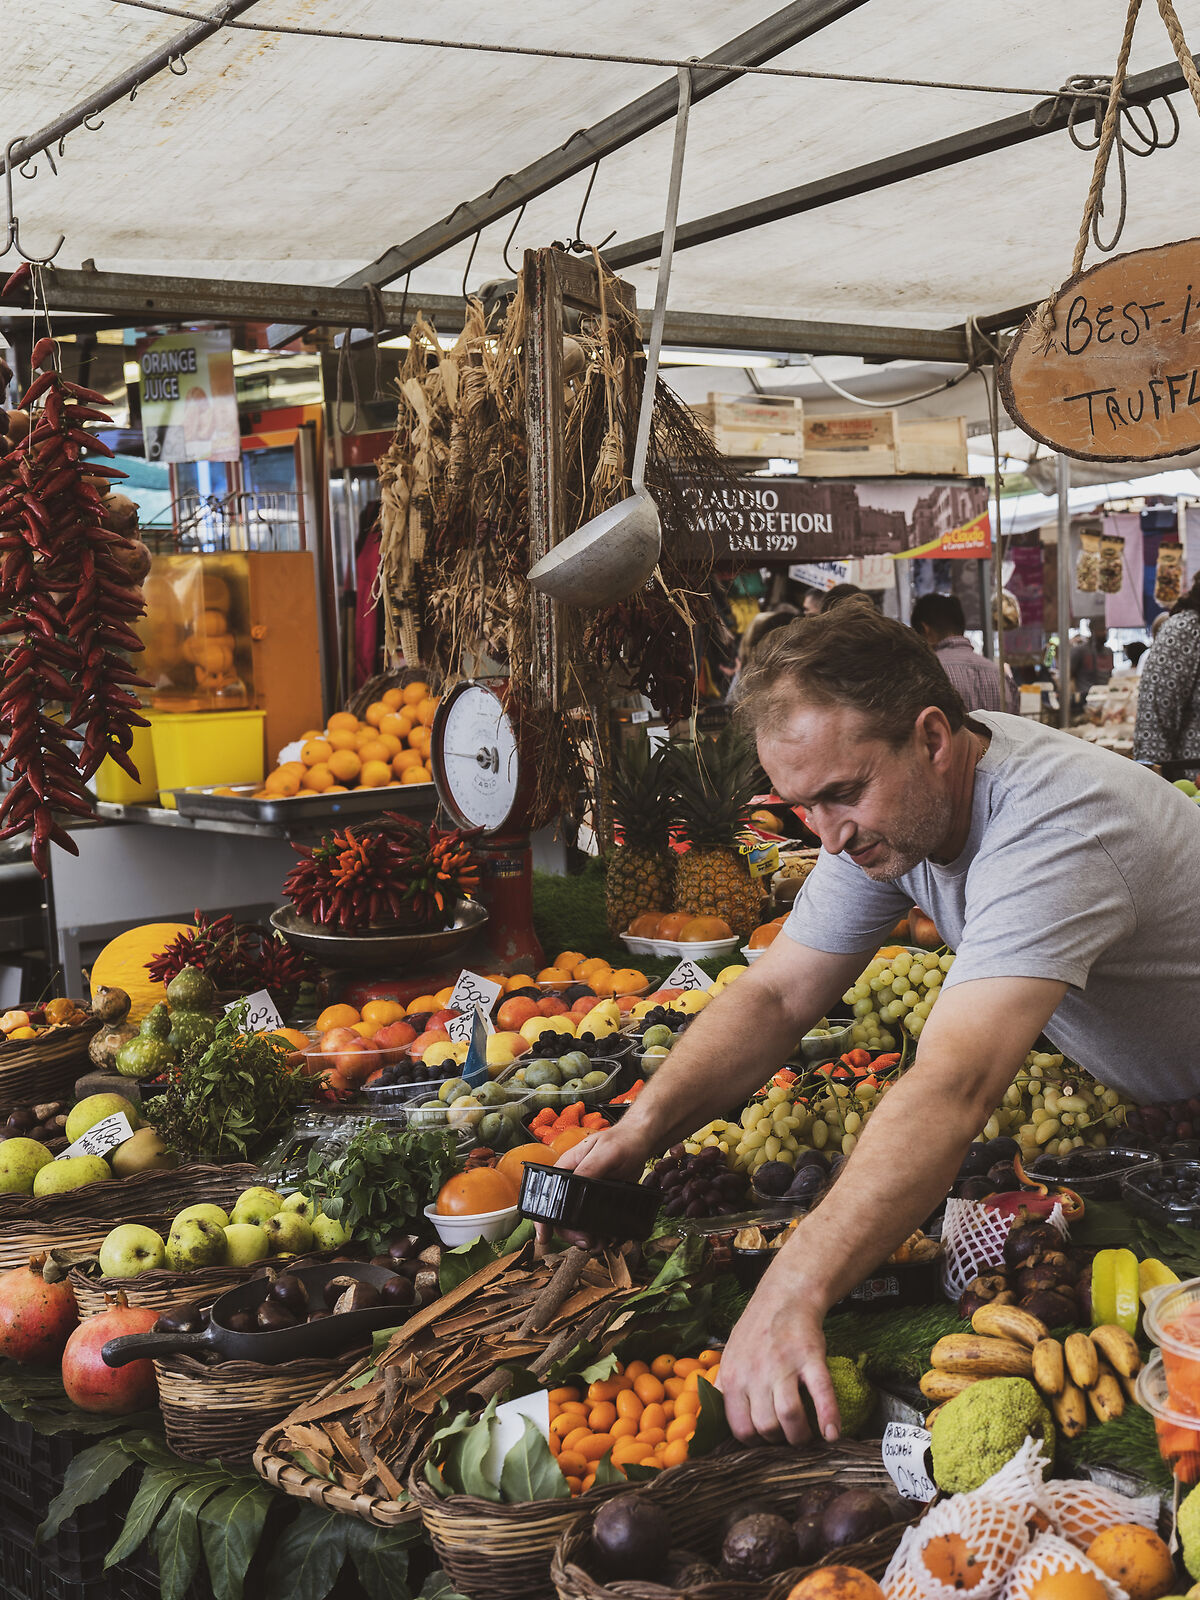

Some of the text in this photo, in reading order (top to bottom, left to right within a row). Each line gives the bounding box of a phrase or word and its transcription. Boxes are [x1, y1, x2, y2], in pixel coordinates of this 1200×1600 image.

[142, 349, 197, 375] ORANGE
[144, 377, 180, 401] JUICE
[766, 534, 798, 551] 1929
